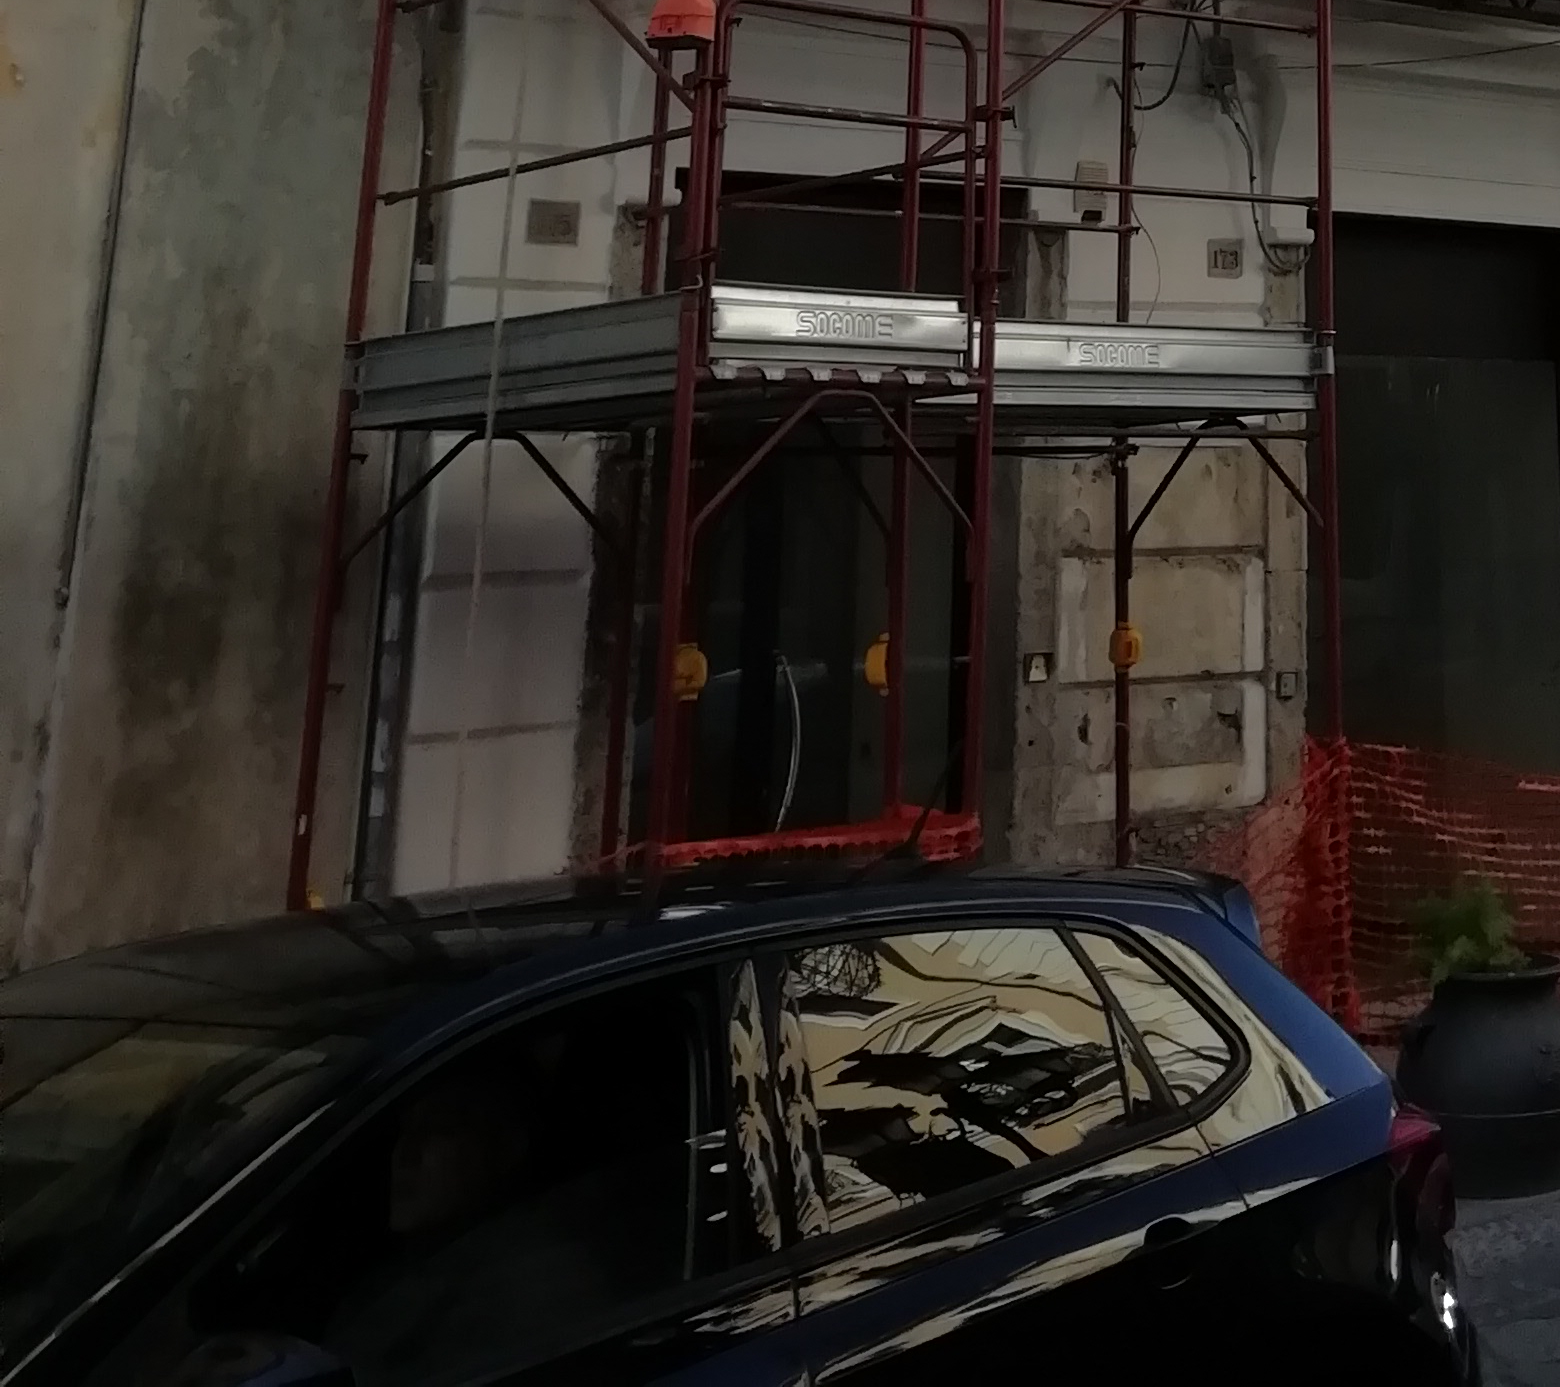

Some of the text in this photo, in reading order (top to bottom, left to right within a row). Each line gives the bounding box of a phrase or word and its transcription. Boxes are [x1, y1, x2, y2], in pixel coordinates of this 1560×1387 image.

[1212, 248, 1239, 270] 173
[797, 310, 893, 340] SOCOME
[1079, 344, 1158, 368] SOCOME
